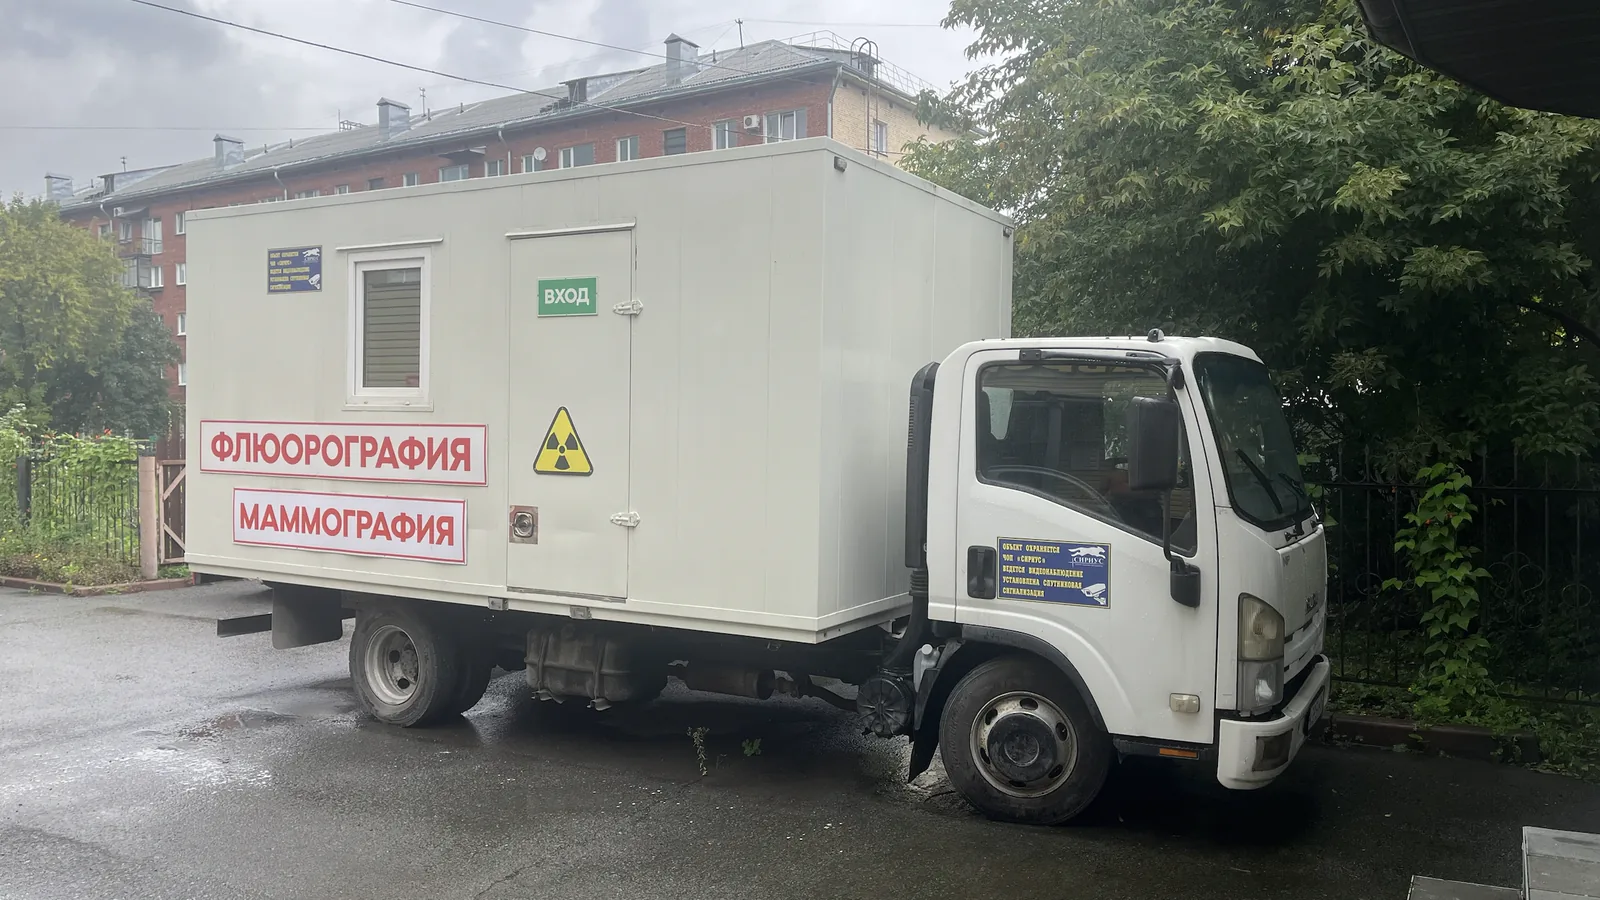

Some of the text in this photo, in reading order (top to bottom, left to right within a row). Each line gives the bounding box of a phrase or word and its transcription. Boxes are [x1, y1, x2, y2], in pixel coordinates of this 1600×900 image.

[544, 287, 590, 306] ВХОД
[210, 431, 471, 472] ФЛЮОРОГРАФИЯ
[239, 502, 454, 546] МАММОГРАФИЯ
[1026, 544, 1060, 554] ОХРАНЯЕТСЯ
[1074, 556, 1104, 564] СИРИУС
